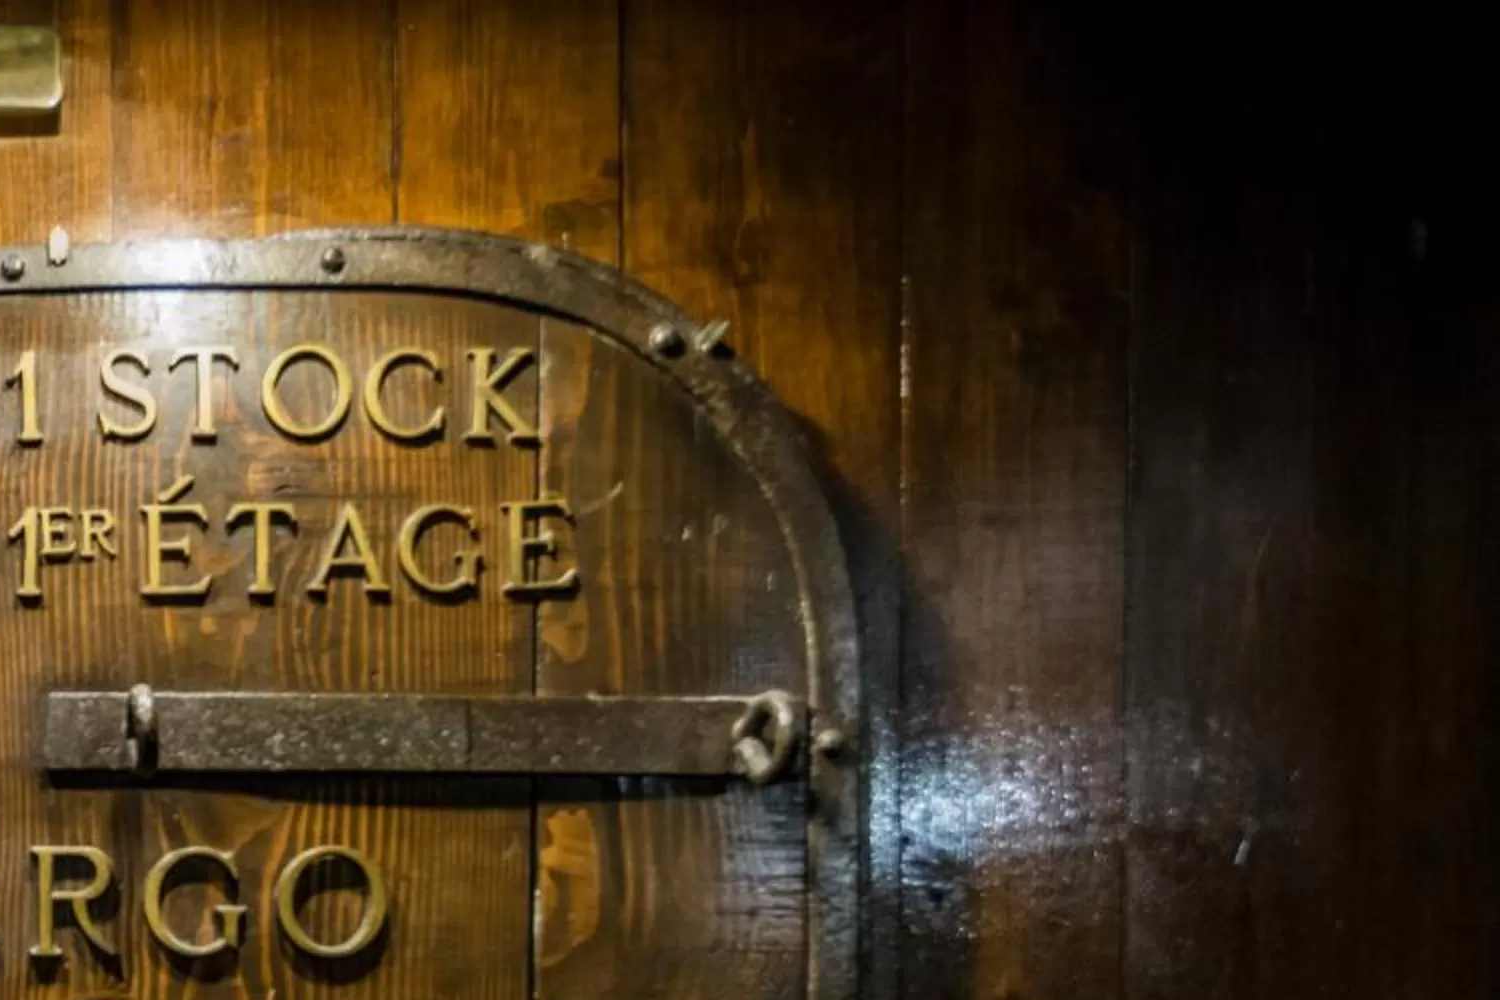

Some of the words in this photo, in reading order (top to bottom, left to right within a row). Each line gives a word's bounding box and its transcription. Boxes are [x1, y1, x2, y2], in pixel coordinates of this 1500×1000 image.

[5, 350, 44, 446] 1
[97, 344, 540, 446] STOCK
[9, 503, 118, 602] 1ER
[140, 474, 580, 602] ÉTAGE
